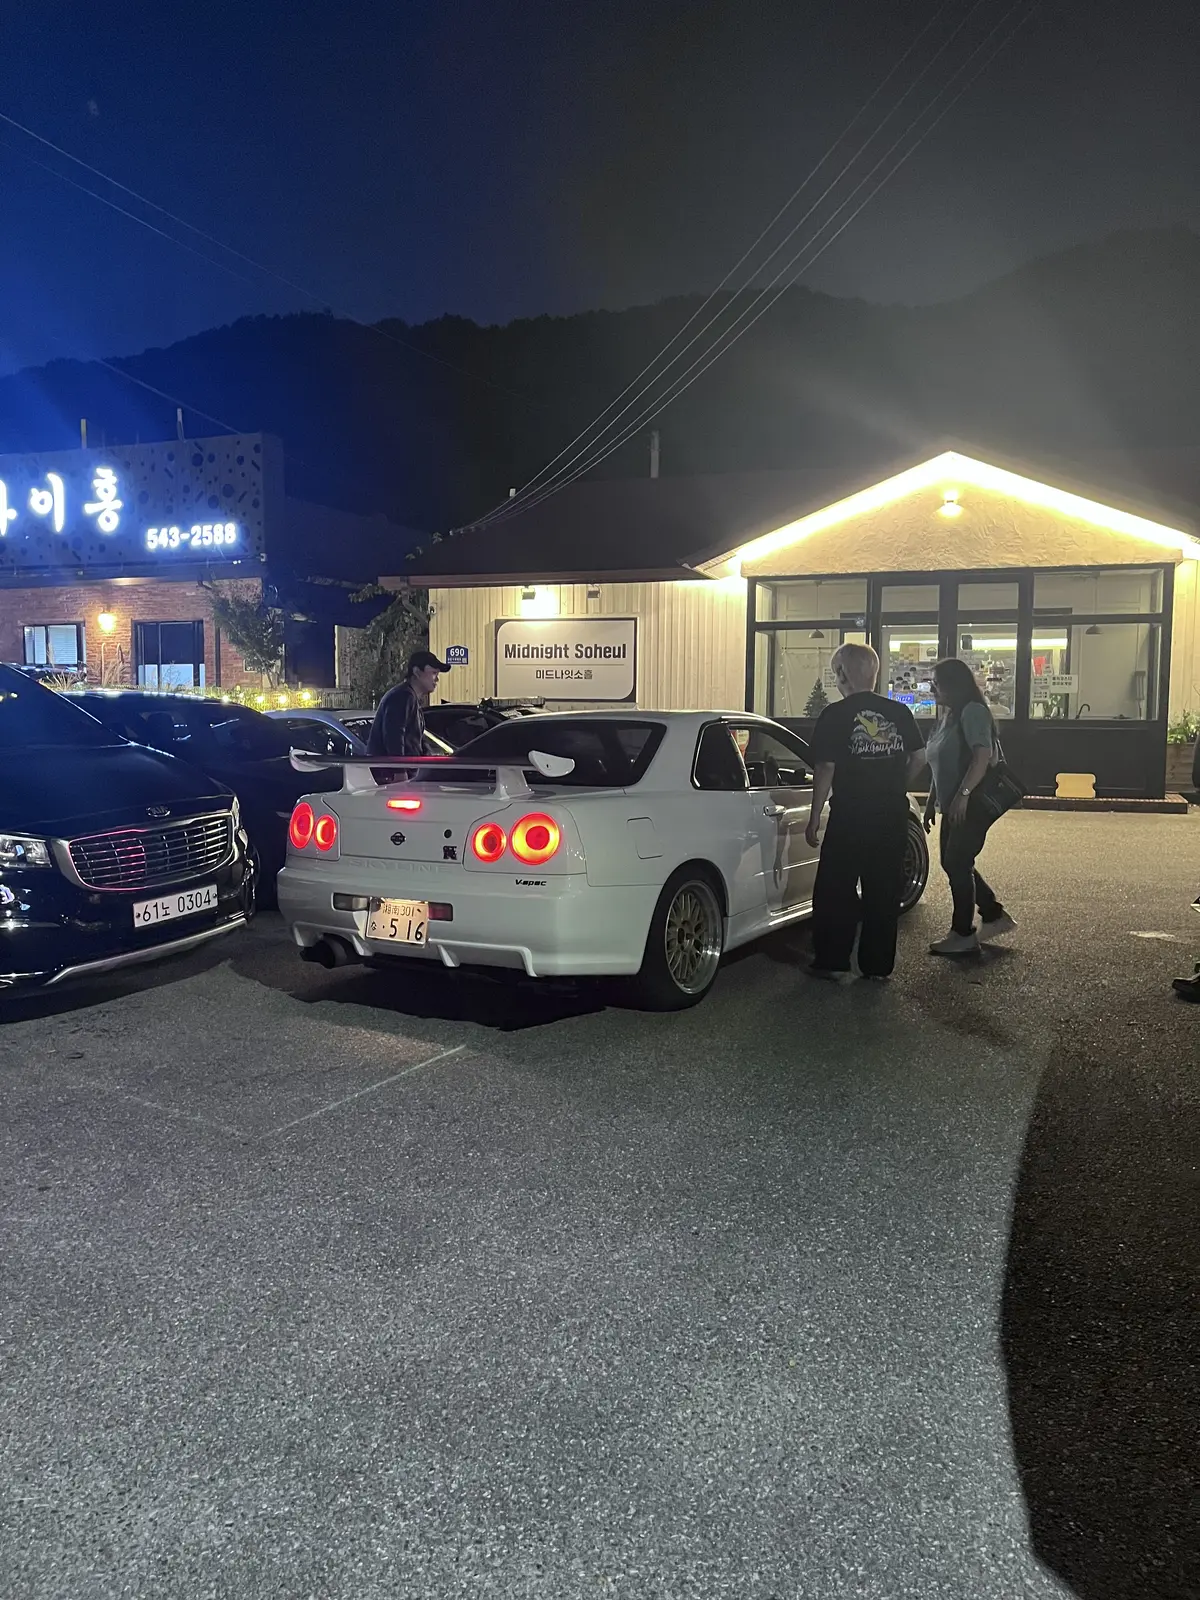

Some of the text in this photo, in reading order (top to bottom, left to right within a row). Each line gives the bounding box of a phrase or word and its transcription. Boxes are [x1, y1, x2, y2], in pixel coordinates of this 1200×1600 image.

[147, 522, 236, 549] 543-2588
[450, 648, 465, 656] 690
[504, 643, 627, 660] Midnight Soheul
[348, 858, 453, 874] SKYLINE
[142, 889, 212, 922] 61노 0304
